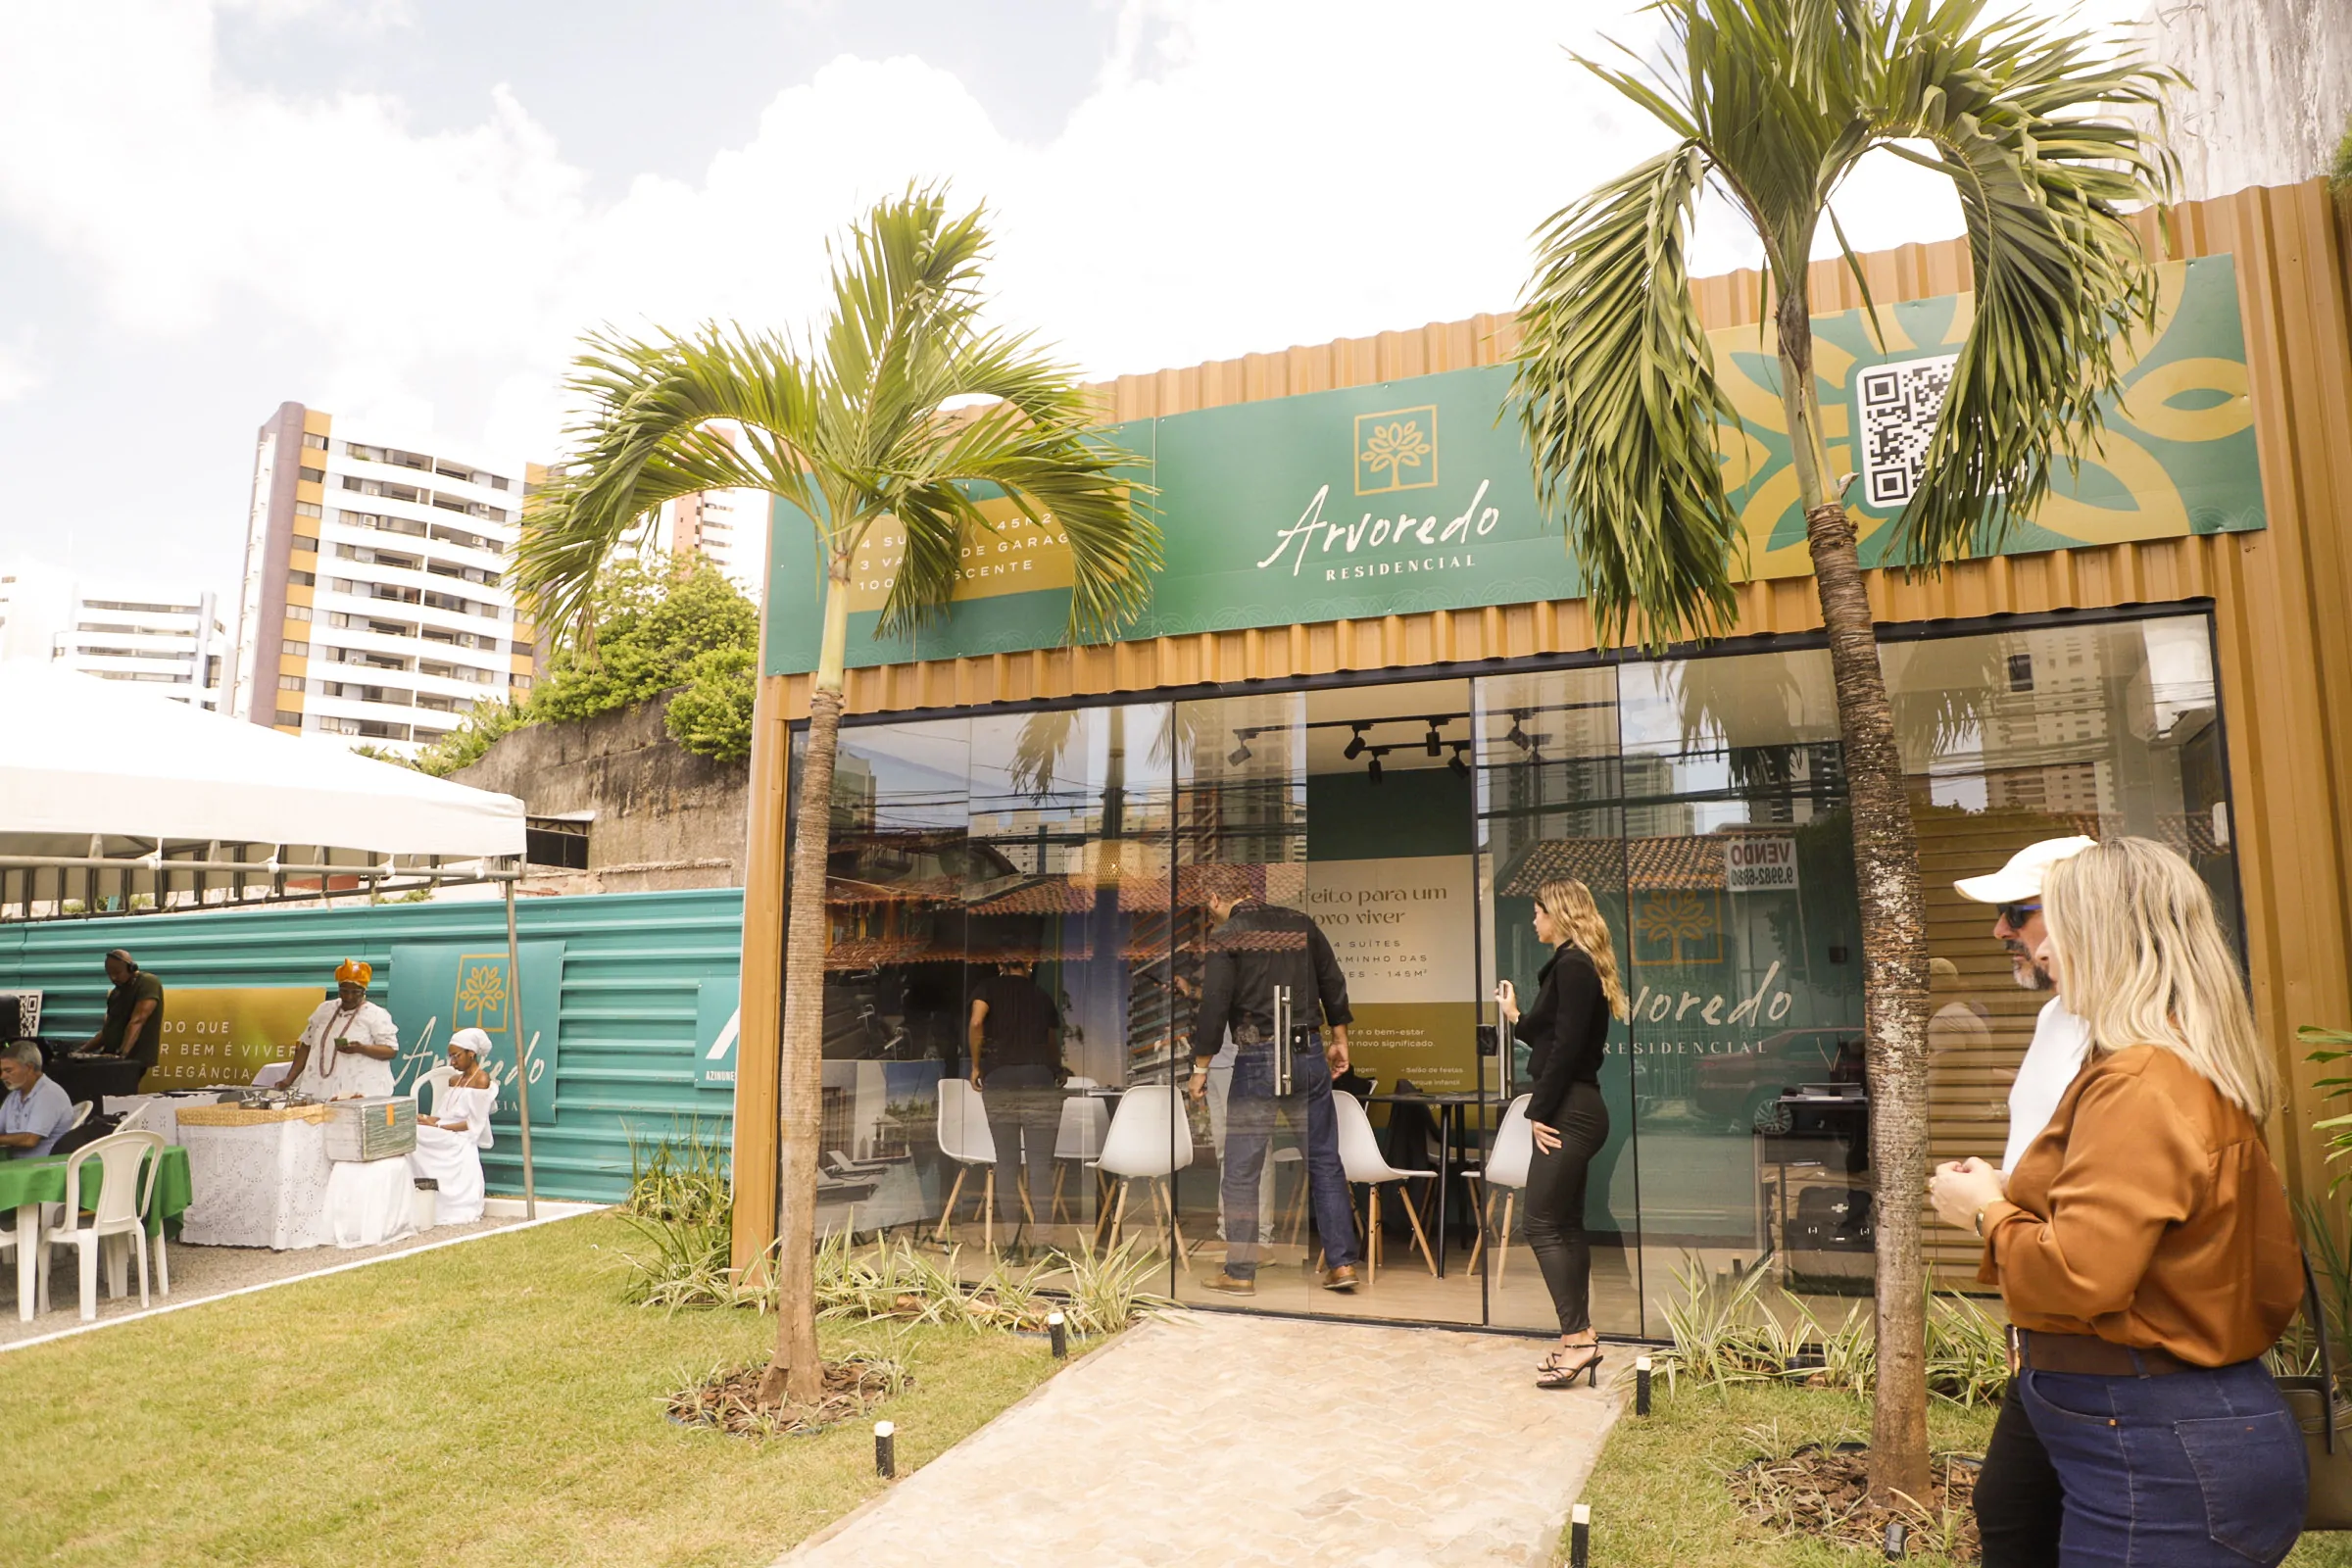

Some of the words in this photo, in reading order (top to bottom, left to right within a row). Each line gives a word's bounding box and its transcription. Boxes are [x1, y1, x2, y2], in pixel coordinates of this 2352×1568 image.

[1256, 479, 1498, 576] Arvoredo
[860, 560, 869, 570] 3
[961, 545, 985, 558] DE
[998, 532, 1068, 553] GARAG
[861, 539, 871, 549] 4
[859, 578, 894, 590] 100
[954, 560, 1033, 580] SCENTE
[1326, 554, 1476, 581] RESIDENCIAL
[1358, 889, 1407, 906] para
[1413, 887, 1447, 901] um
[1313, 913, 1349, 925] ovo
[1356, 909, 1405, 924] viver
[1337, 955, 1391, 963] AMINHO
[1623, 959, 1792, 1027] voredo
[196, 1021, 229, 1034] QUE
[180, 1044, 215, 1055] BEM
[224, 1042, 232, 1055] É
